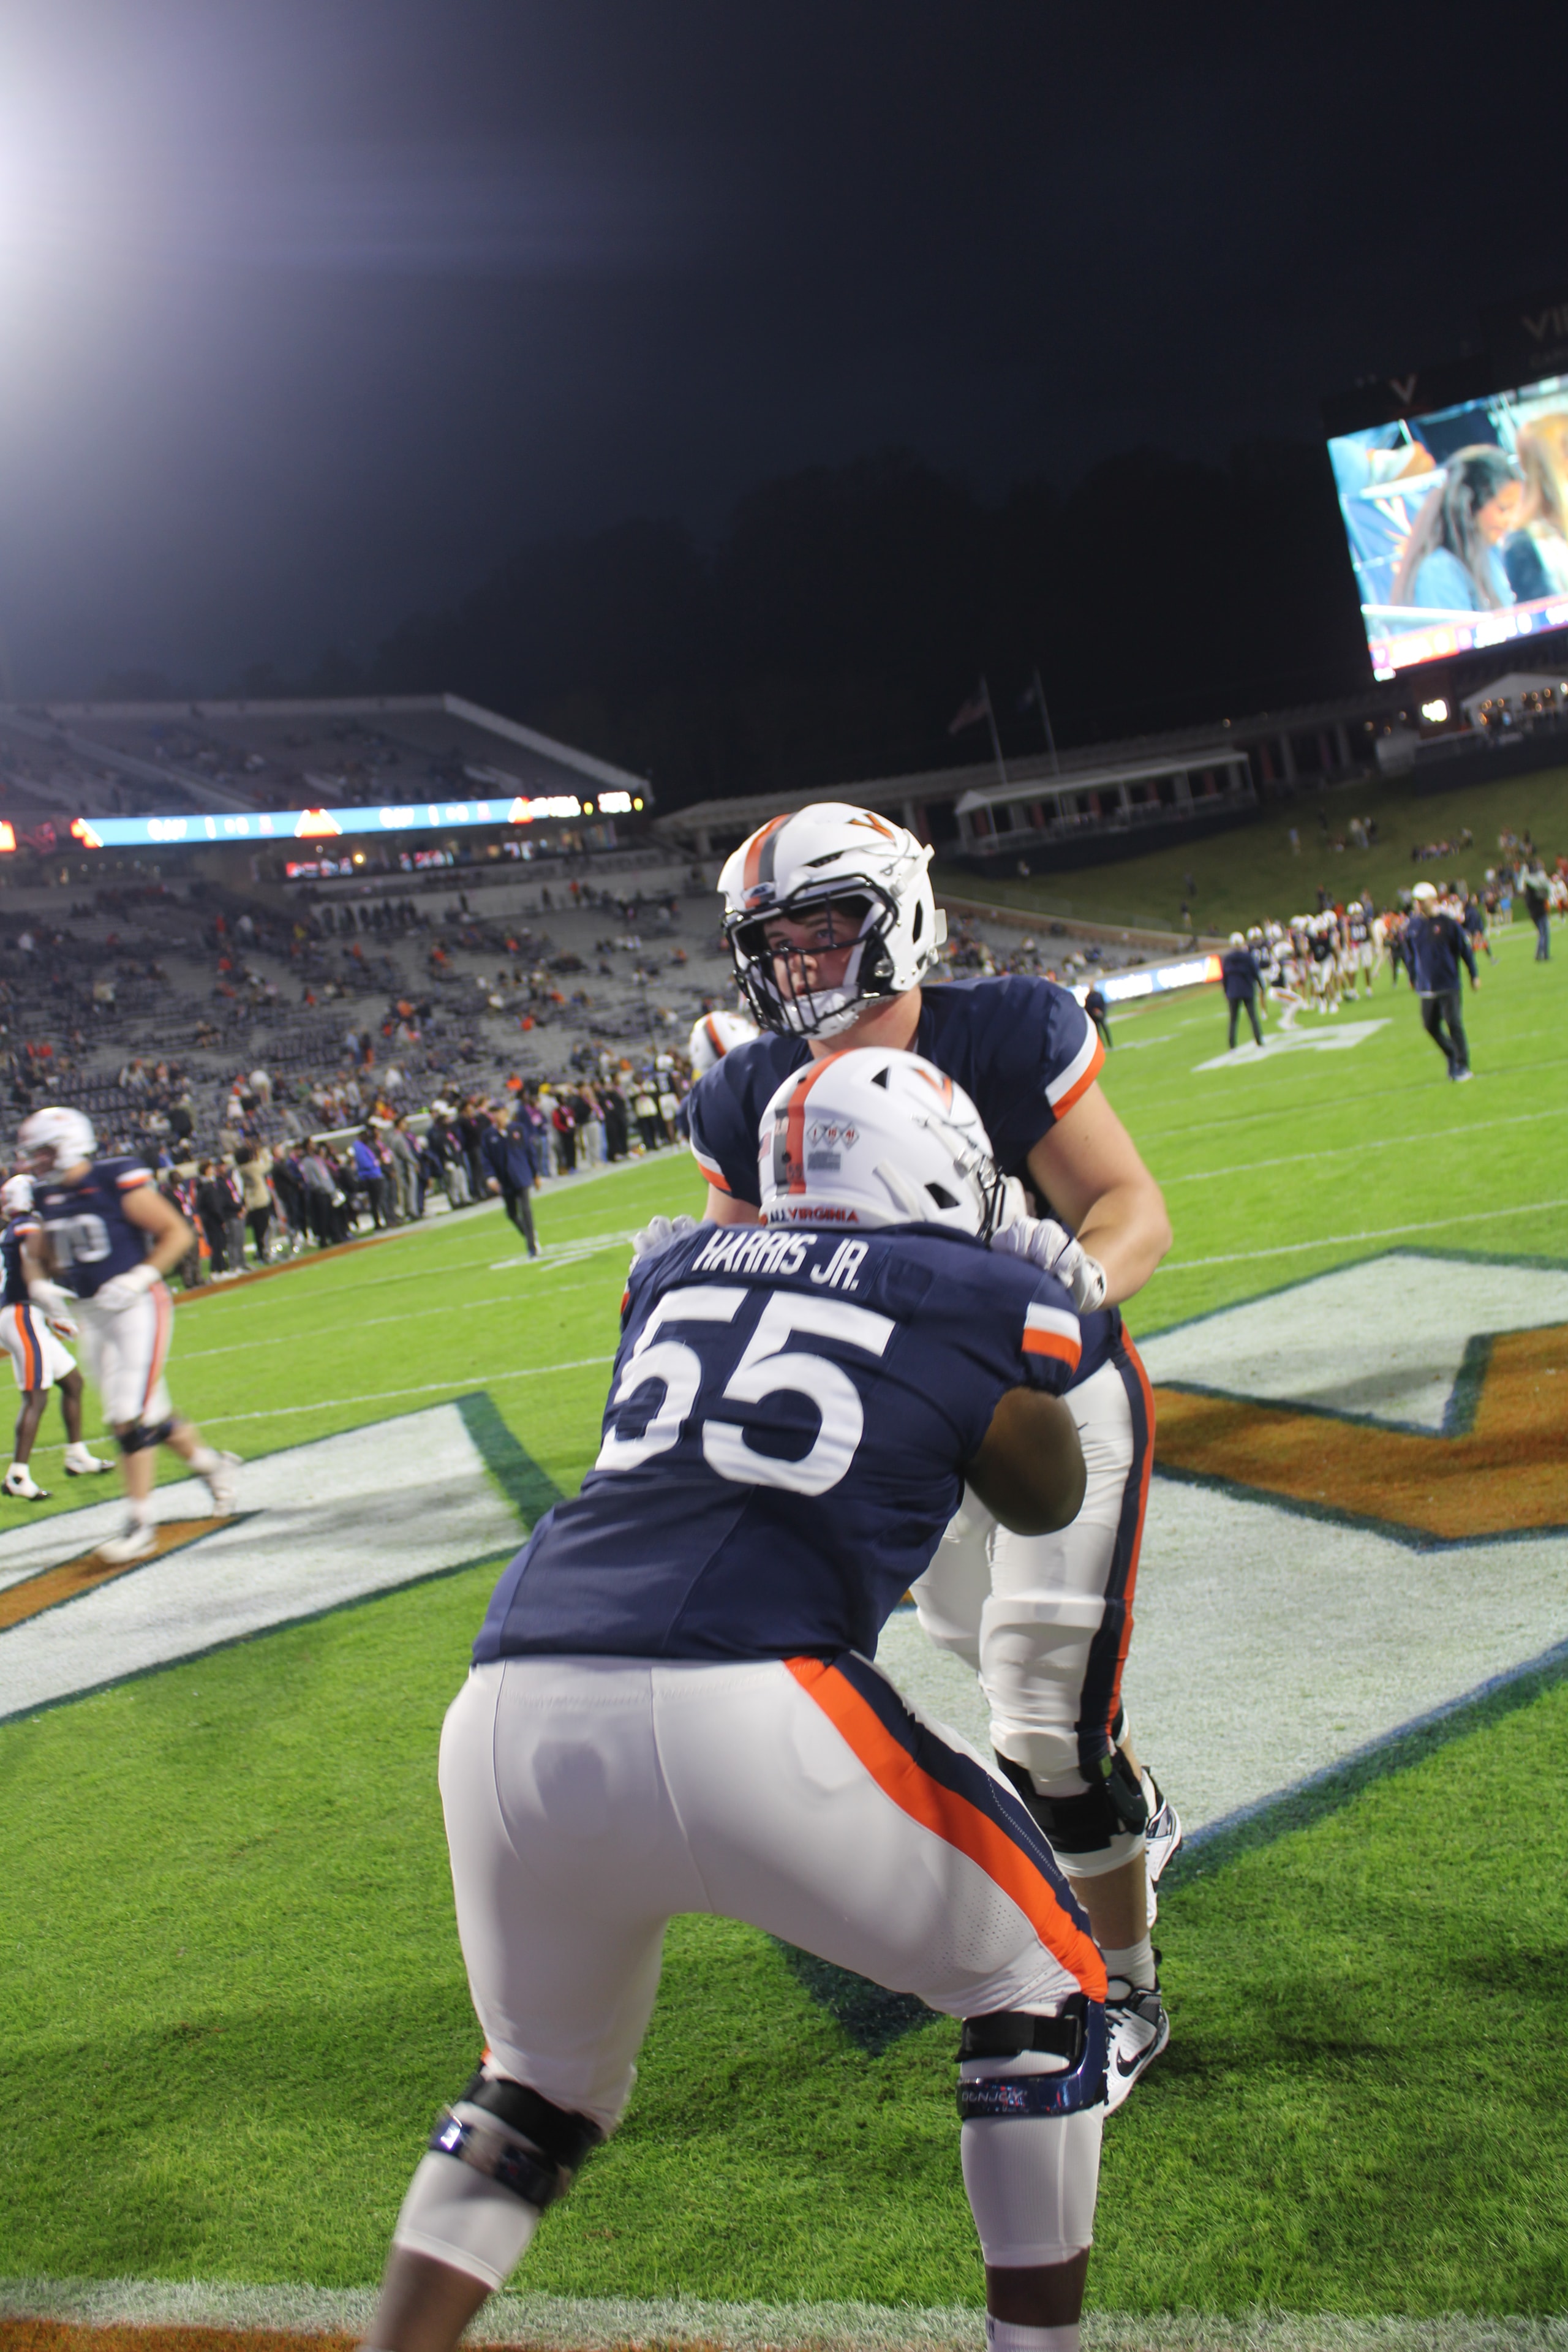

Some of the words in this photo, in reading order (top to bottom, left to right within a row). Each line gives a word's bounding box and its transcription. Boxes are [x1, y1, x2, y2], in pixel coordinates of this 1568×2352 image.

[1520, 303, 1568, 343] VI
[692, 1229, 817, 1275] HARRIS
[810, 1238, 869, 1291] JR.
[595, 1285, 896, 1497] 55
